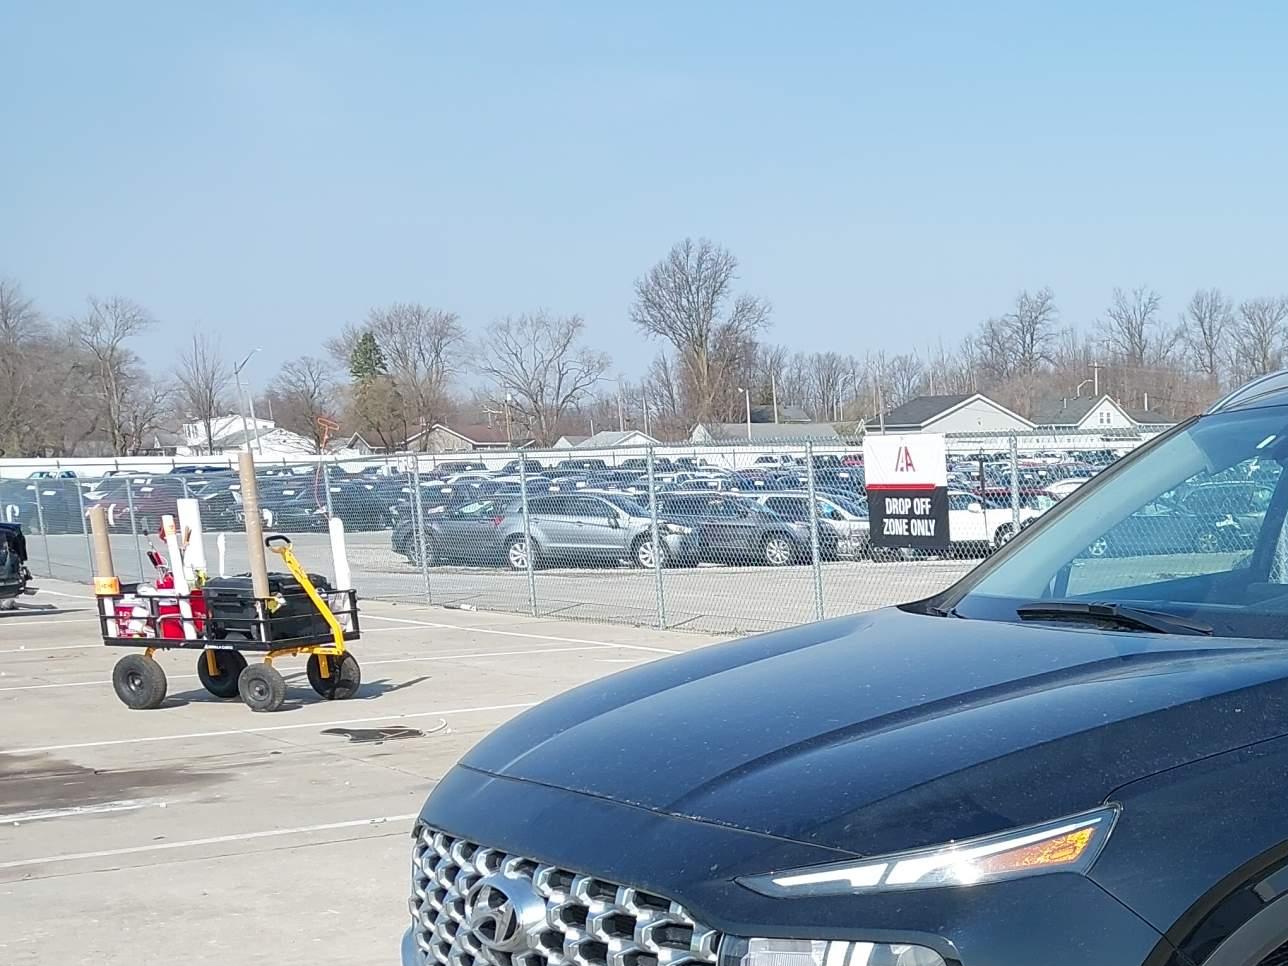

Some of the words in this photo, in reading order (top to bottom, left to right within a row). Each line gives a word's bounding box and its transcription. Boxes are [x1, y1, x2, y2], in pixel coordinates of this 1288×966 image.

[885, 497, 911, 515] DROP
[913, 498, 931, 515] OFF
[883, 518, 909, 536] ZONE
[910, 518, 936, 536] ONLY
